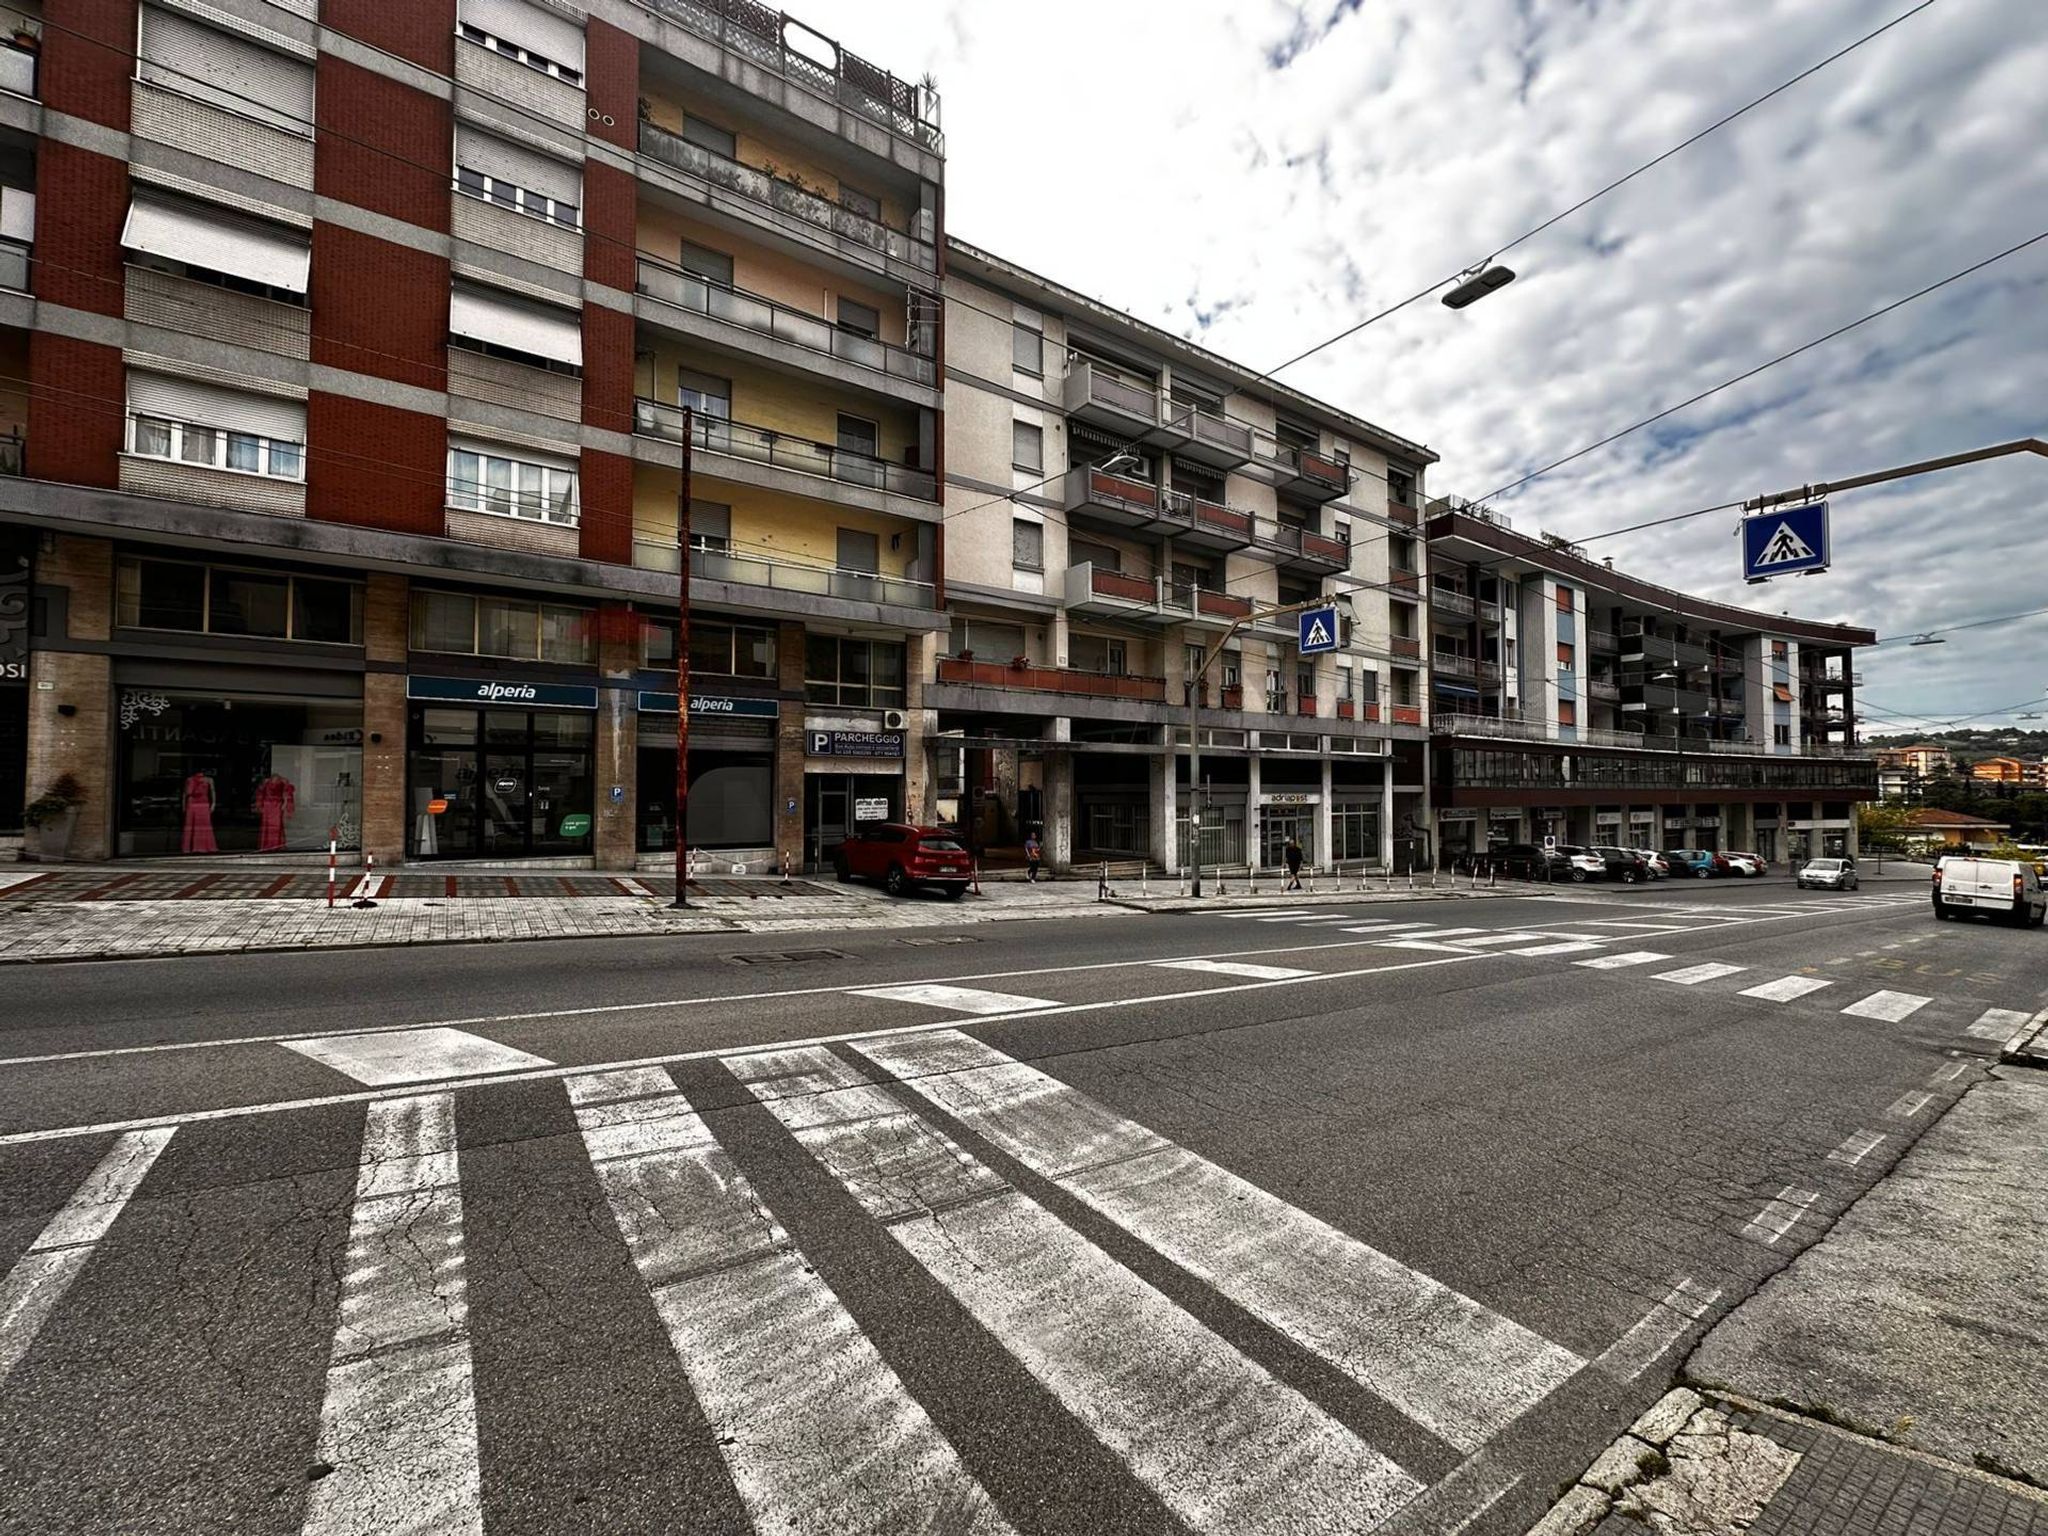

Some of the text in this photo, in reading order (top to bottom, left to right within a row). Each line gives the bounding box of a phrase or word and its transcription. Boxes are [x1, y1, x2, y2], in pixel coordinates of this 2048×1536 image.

[477, 682, 537, 700] alperia
[690, 697, 734, 712] alperia
[814, 733, 828, 751] P
[834, 732, 900, 744] PARCHEGGIO
[614, 787, 621, 796] P
[788, 801, 795, 809] P
